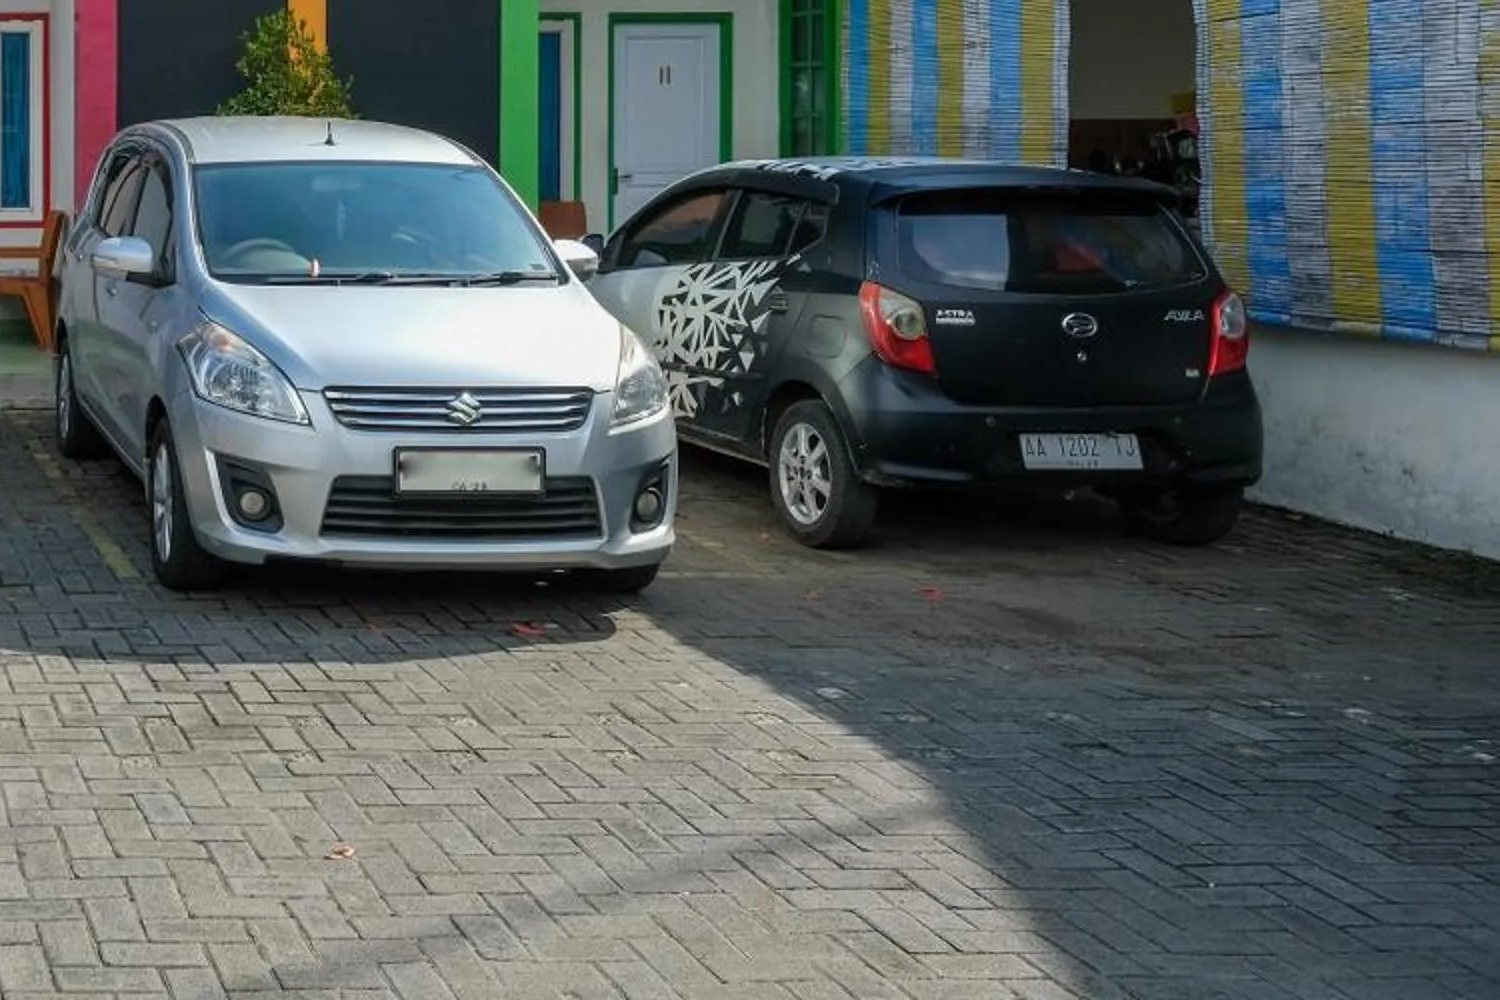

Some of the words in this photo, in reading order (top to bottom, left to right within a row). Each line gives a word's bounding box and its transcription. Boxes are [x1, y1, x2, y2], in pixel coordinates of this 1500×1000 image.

[659, 65, 671, 86] 11
[1025, 435, 1047, 458] AA
[1058, 434, 1101, 457] 1202
